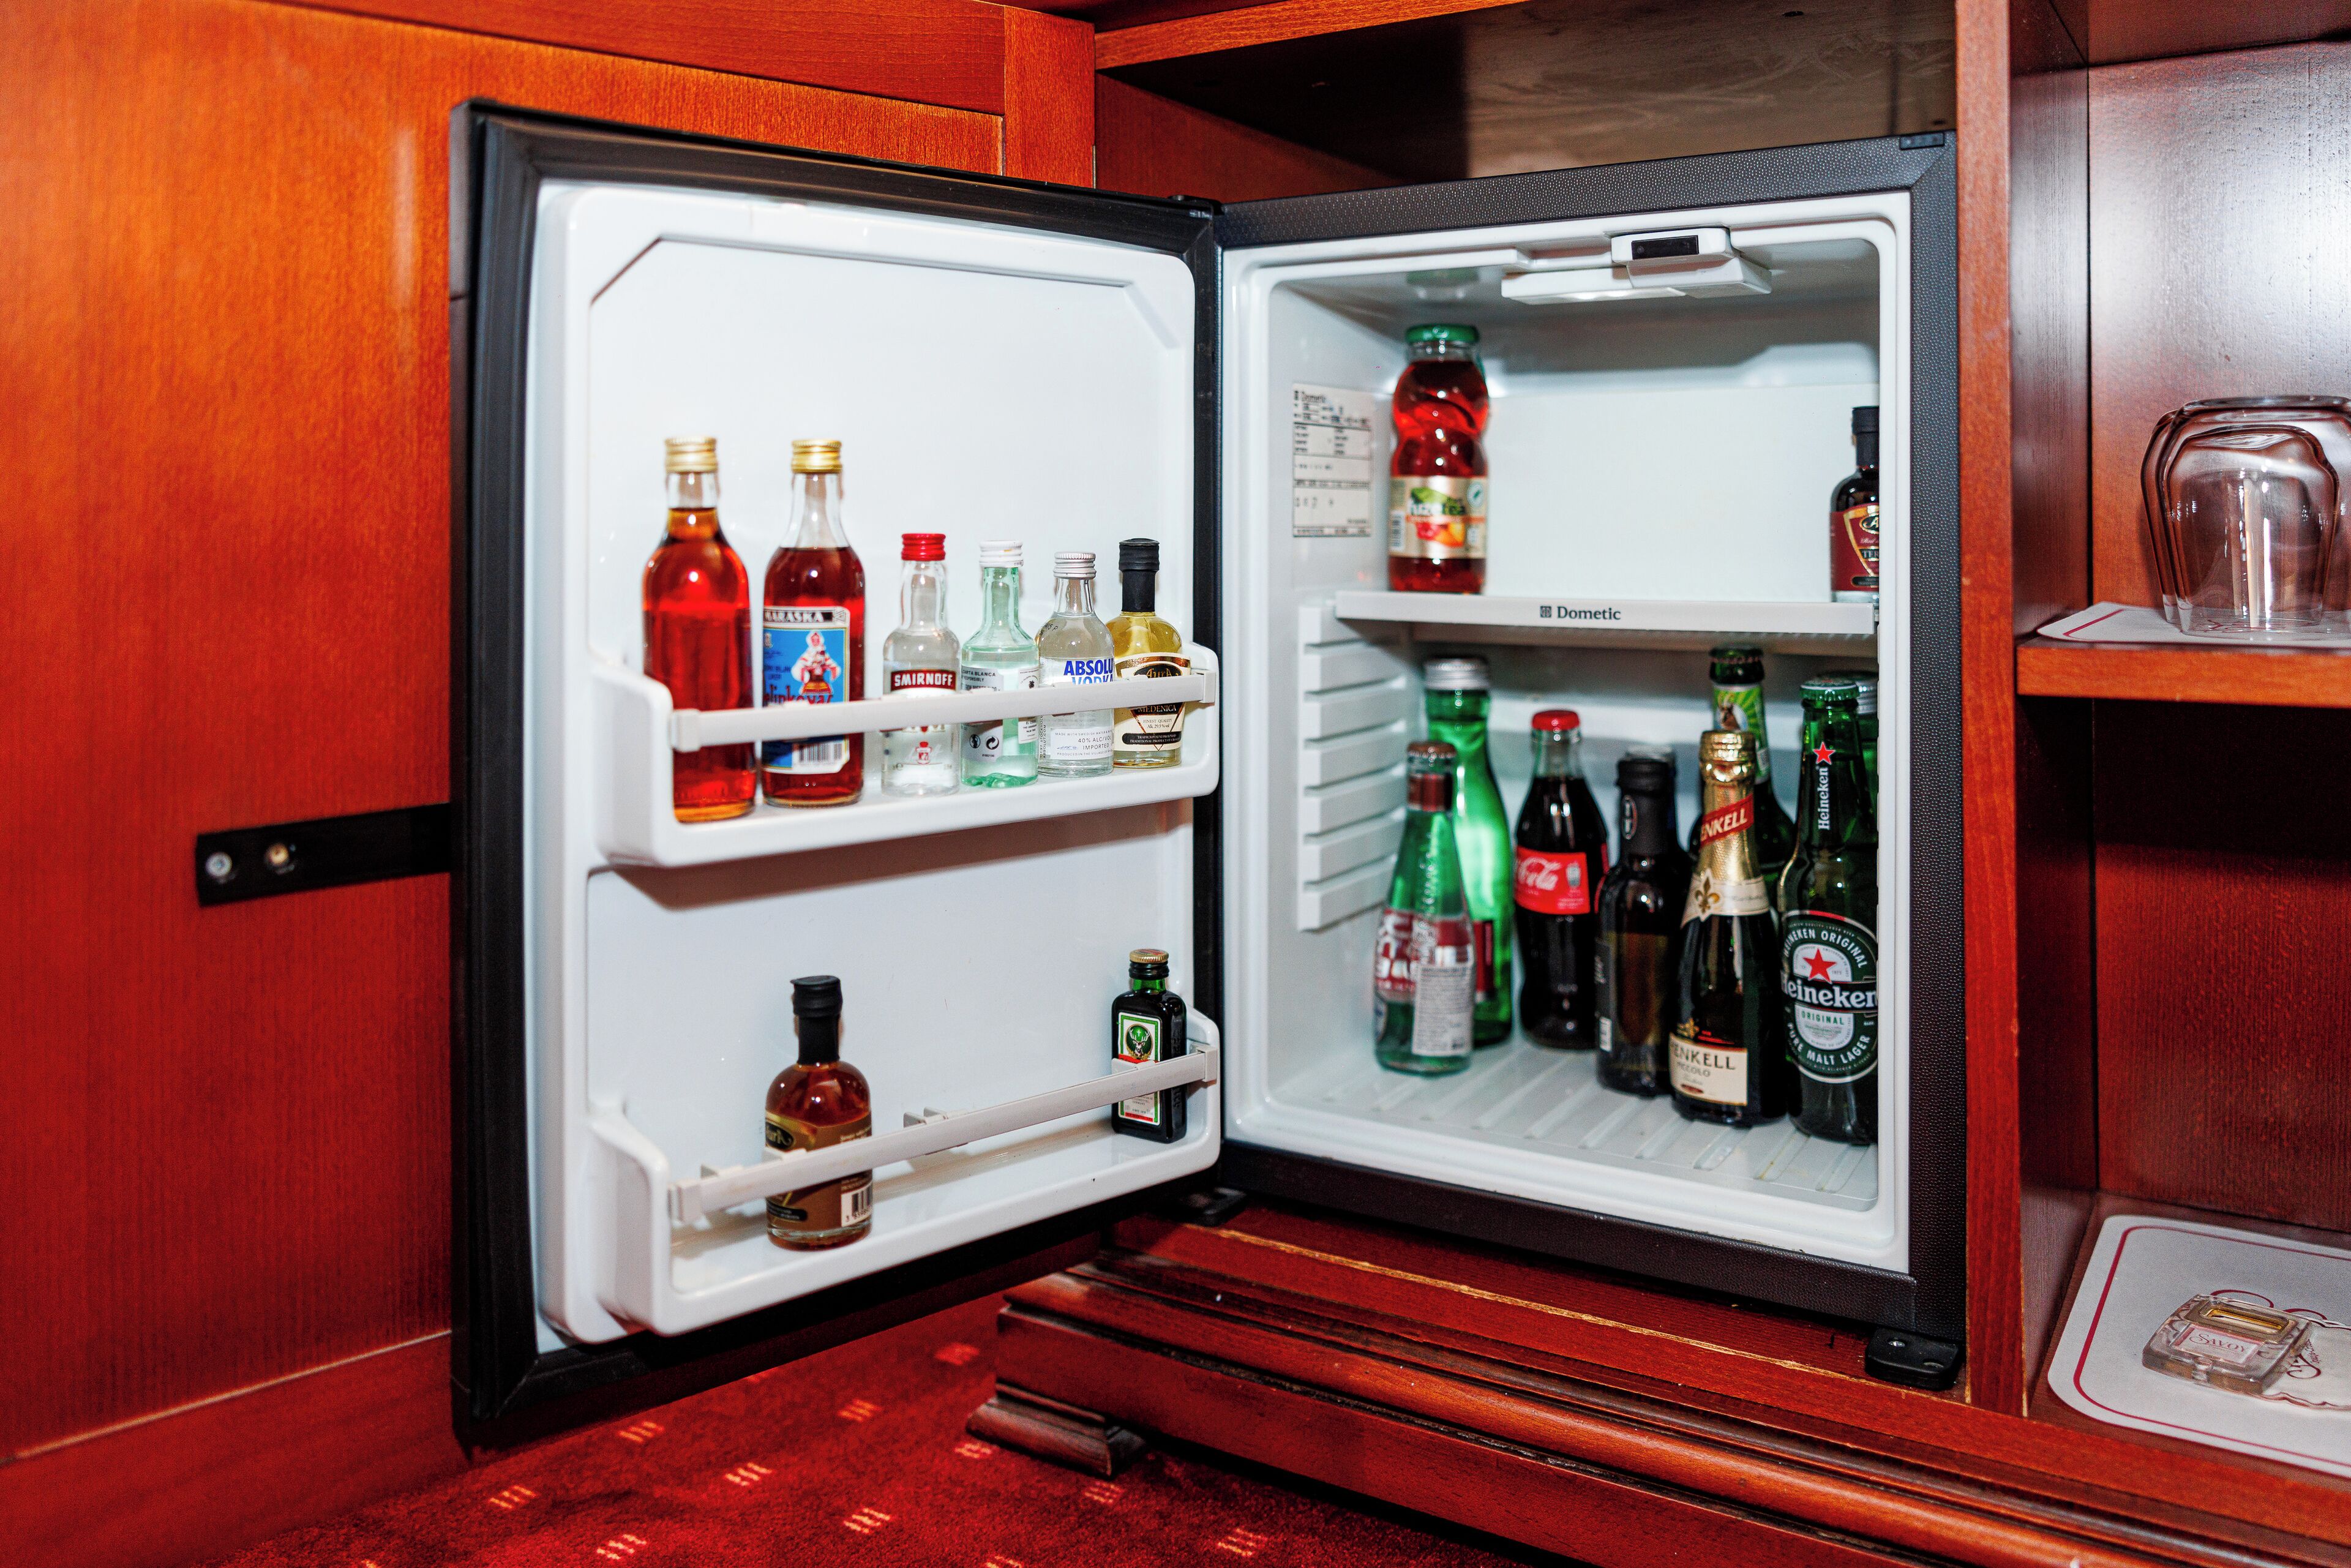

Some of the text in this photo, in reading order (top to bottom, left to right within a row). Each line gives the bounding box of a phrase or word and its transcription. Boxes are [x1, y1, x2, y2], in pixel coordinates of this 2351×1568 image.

[1557, 606, 1621, 620] Dometic
[894, 672, 953, 687] SMIRNOFF
[1817, 767, 1830, 830] Heineken
[1783, 928, 1816, 958] HEINEKEN
[1821, 930, 1867, 969] ORIGINAL
[1801, 1011, 1845, 1025] ORIGINAL
[1787, 1022, 1804, 1052] PURE
[1807, 1049, 1835, 1065] MALT
[1840, 1035, 1871, 1063] LAGER
